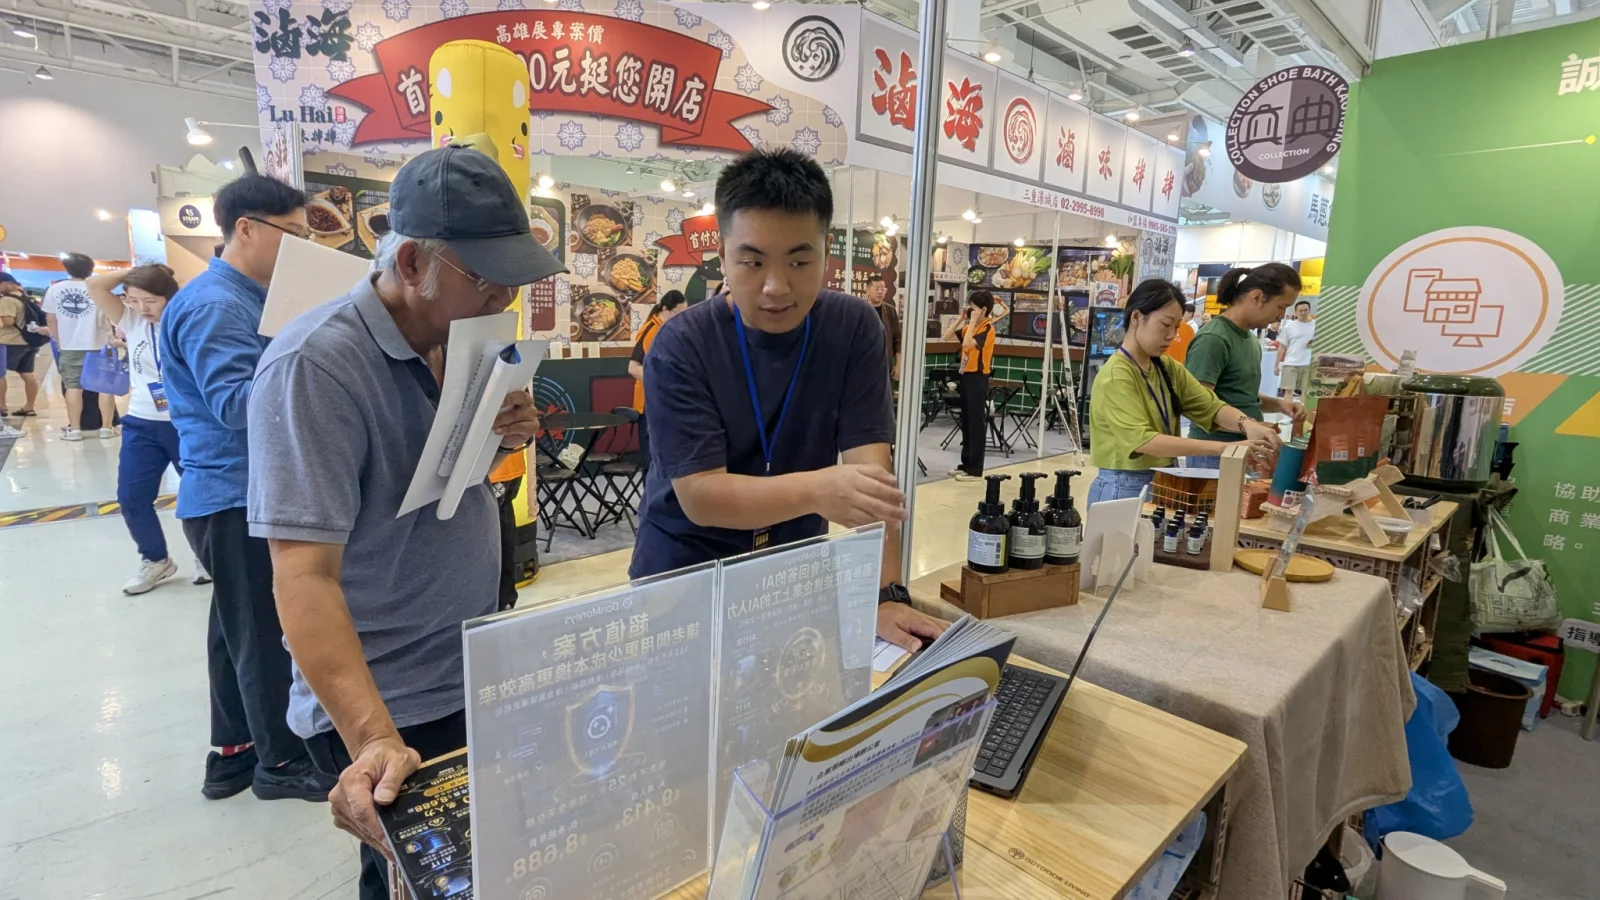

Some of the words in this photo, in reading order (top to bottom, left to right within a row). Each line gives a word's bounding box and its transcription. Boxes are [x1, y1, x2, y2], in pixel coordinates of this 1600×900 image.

[254, 7, 355, 61] 滷海
[495, 20, 605, 44] 高雄展專案價
[515, 48, 706, 122] 0元挺您開店
[269, 105, 294, 123] Lu
[299, 105, 333, 123] Hai
[1228, 90, 1259, 165] COLLECTION
[1260, 68, 1299, 91] SHOE
[1302, 67, 1338, 87] BATH
[1258, 148, 1310, 160] COLLECTION
[1024, 857, 1064, 883] OUTDOOR
[1065, 880, 1091, 898] LIVING
